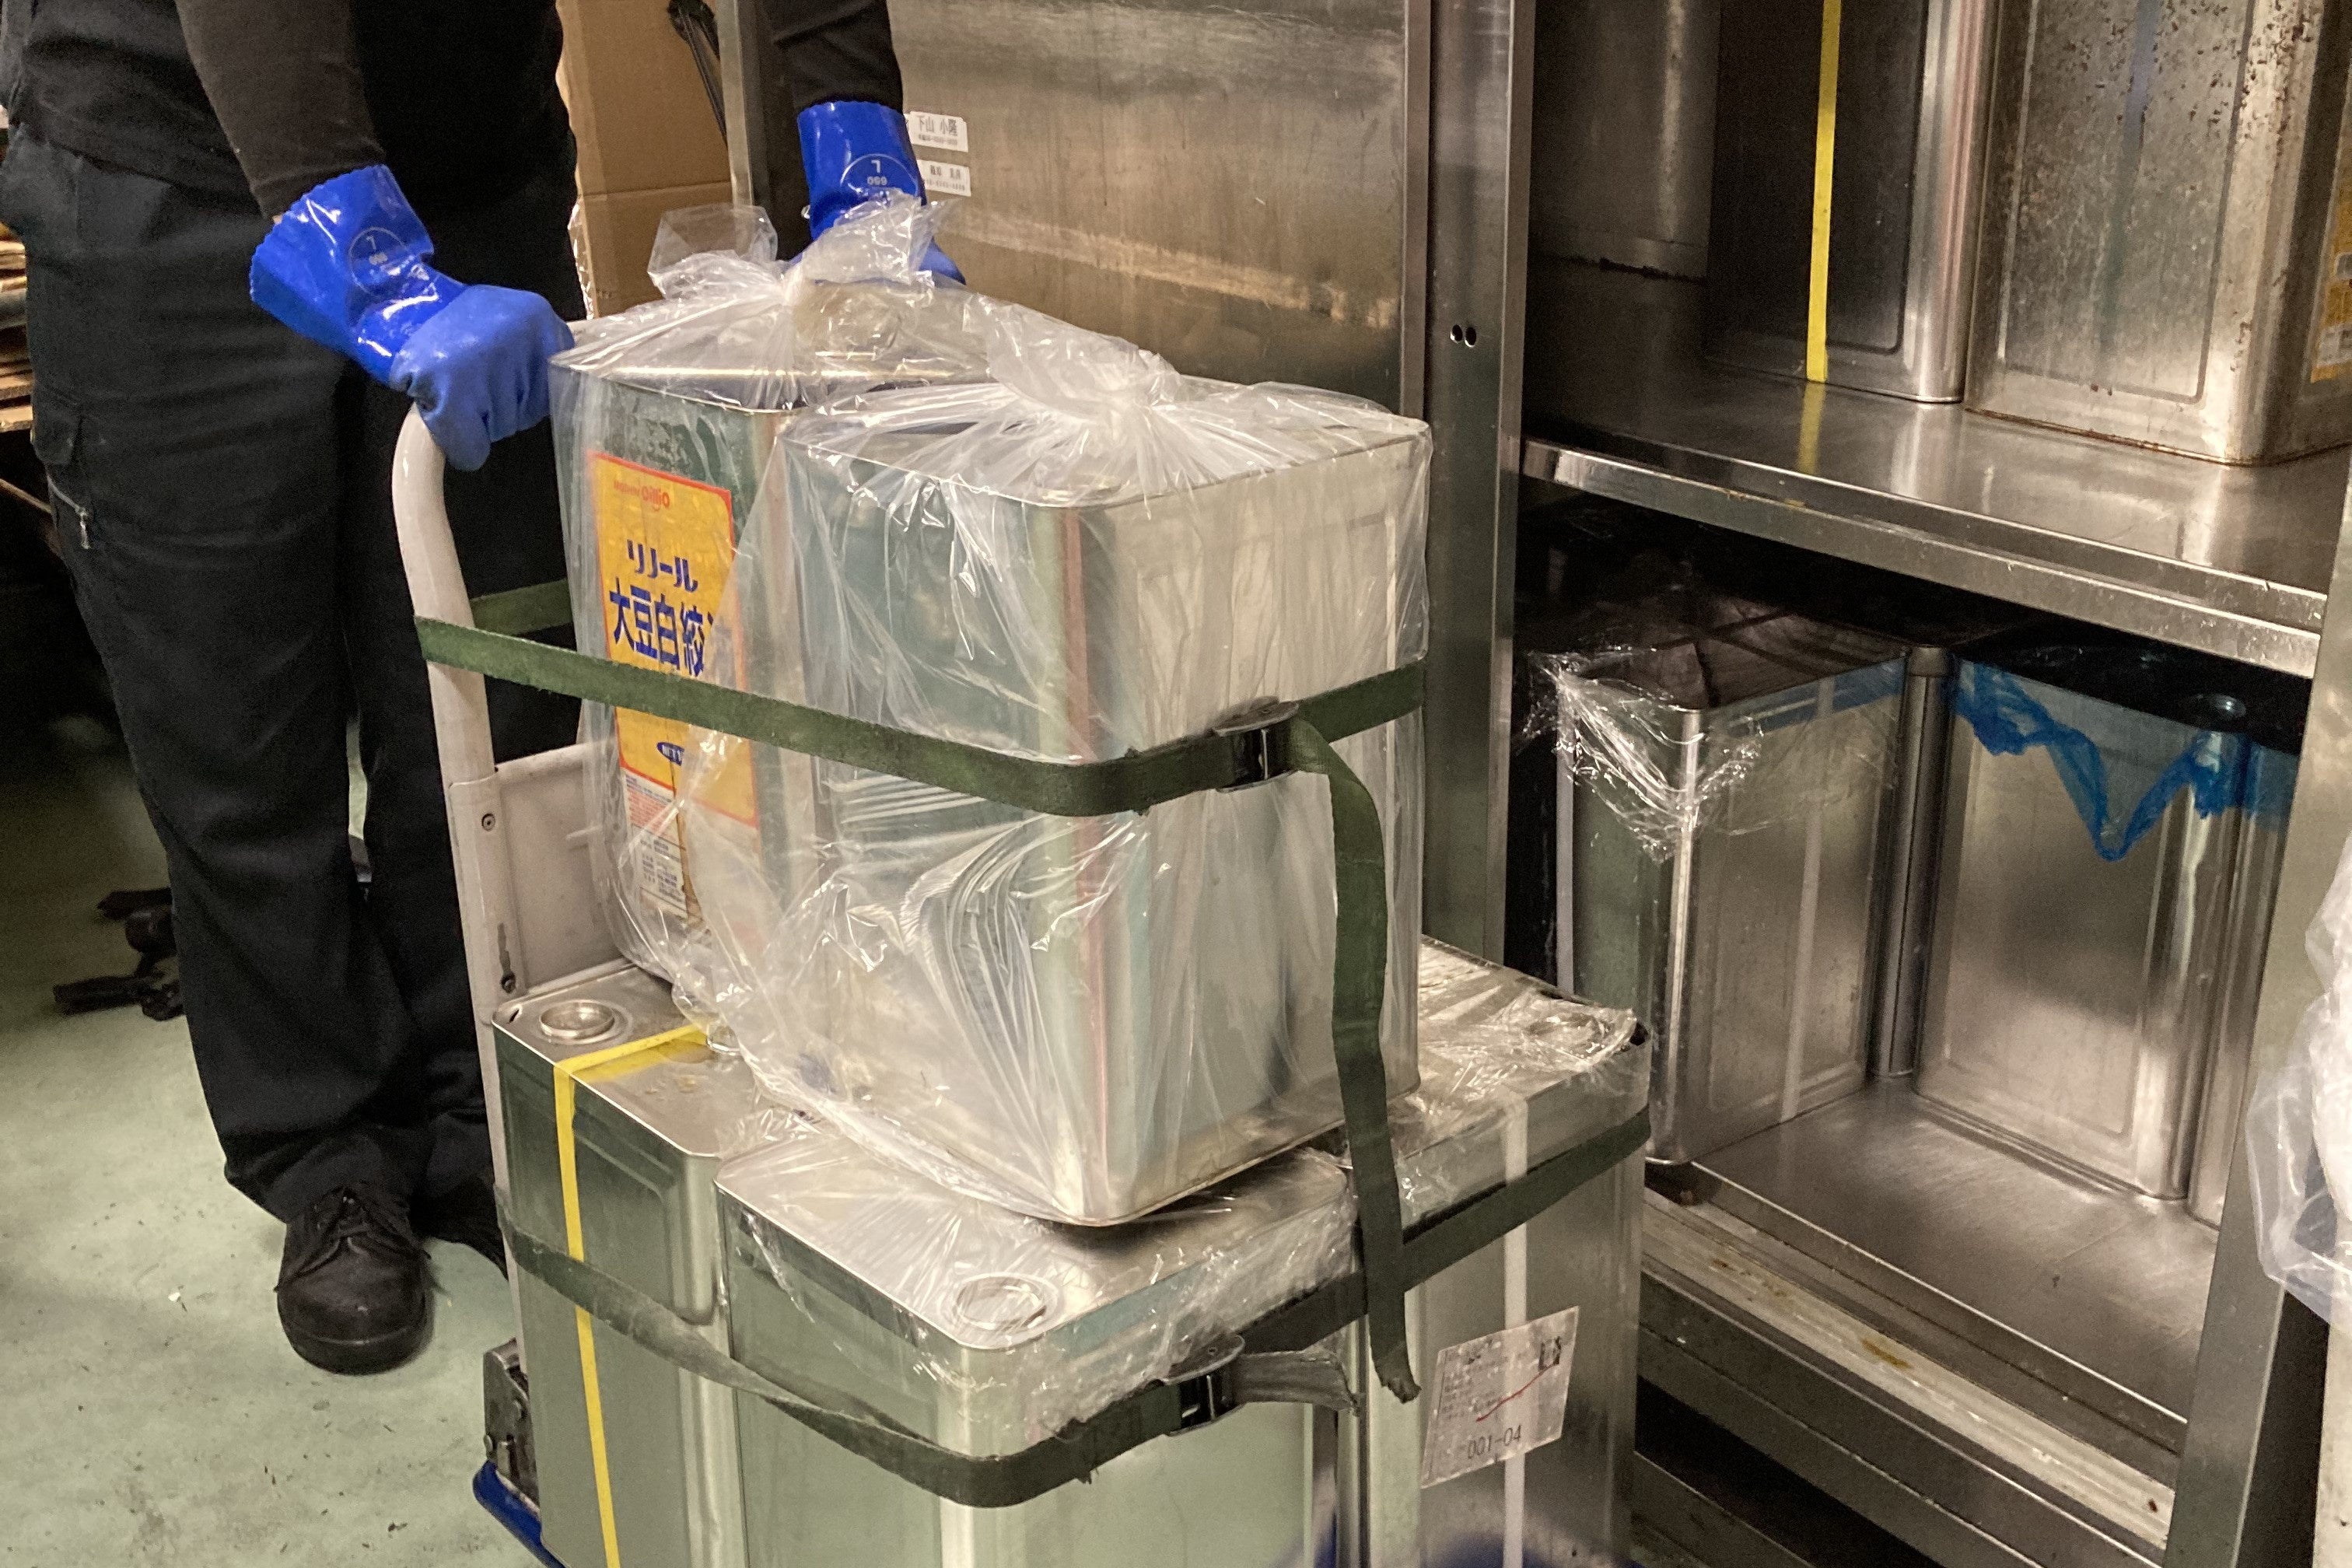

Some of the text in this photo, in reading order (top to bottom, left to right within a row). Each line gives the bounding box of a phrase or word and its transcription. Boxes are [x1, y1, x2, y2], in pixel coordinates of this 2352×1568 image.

[870, 159, 881, 173] L
[626, 539, 698, 593] リノール
[609, 576, 734, 684] 大豆白絞
